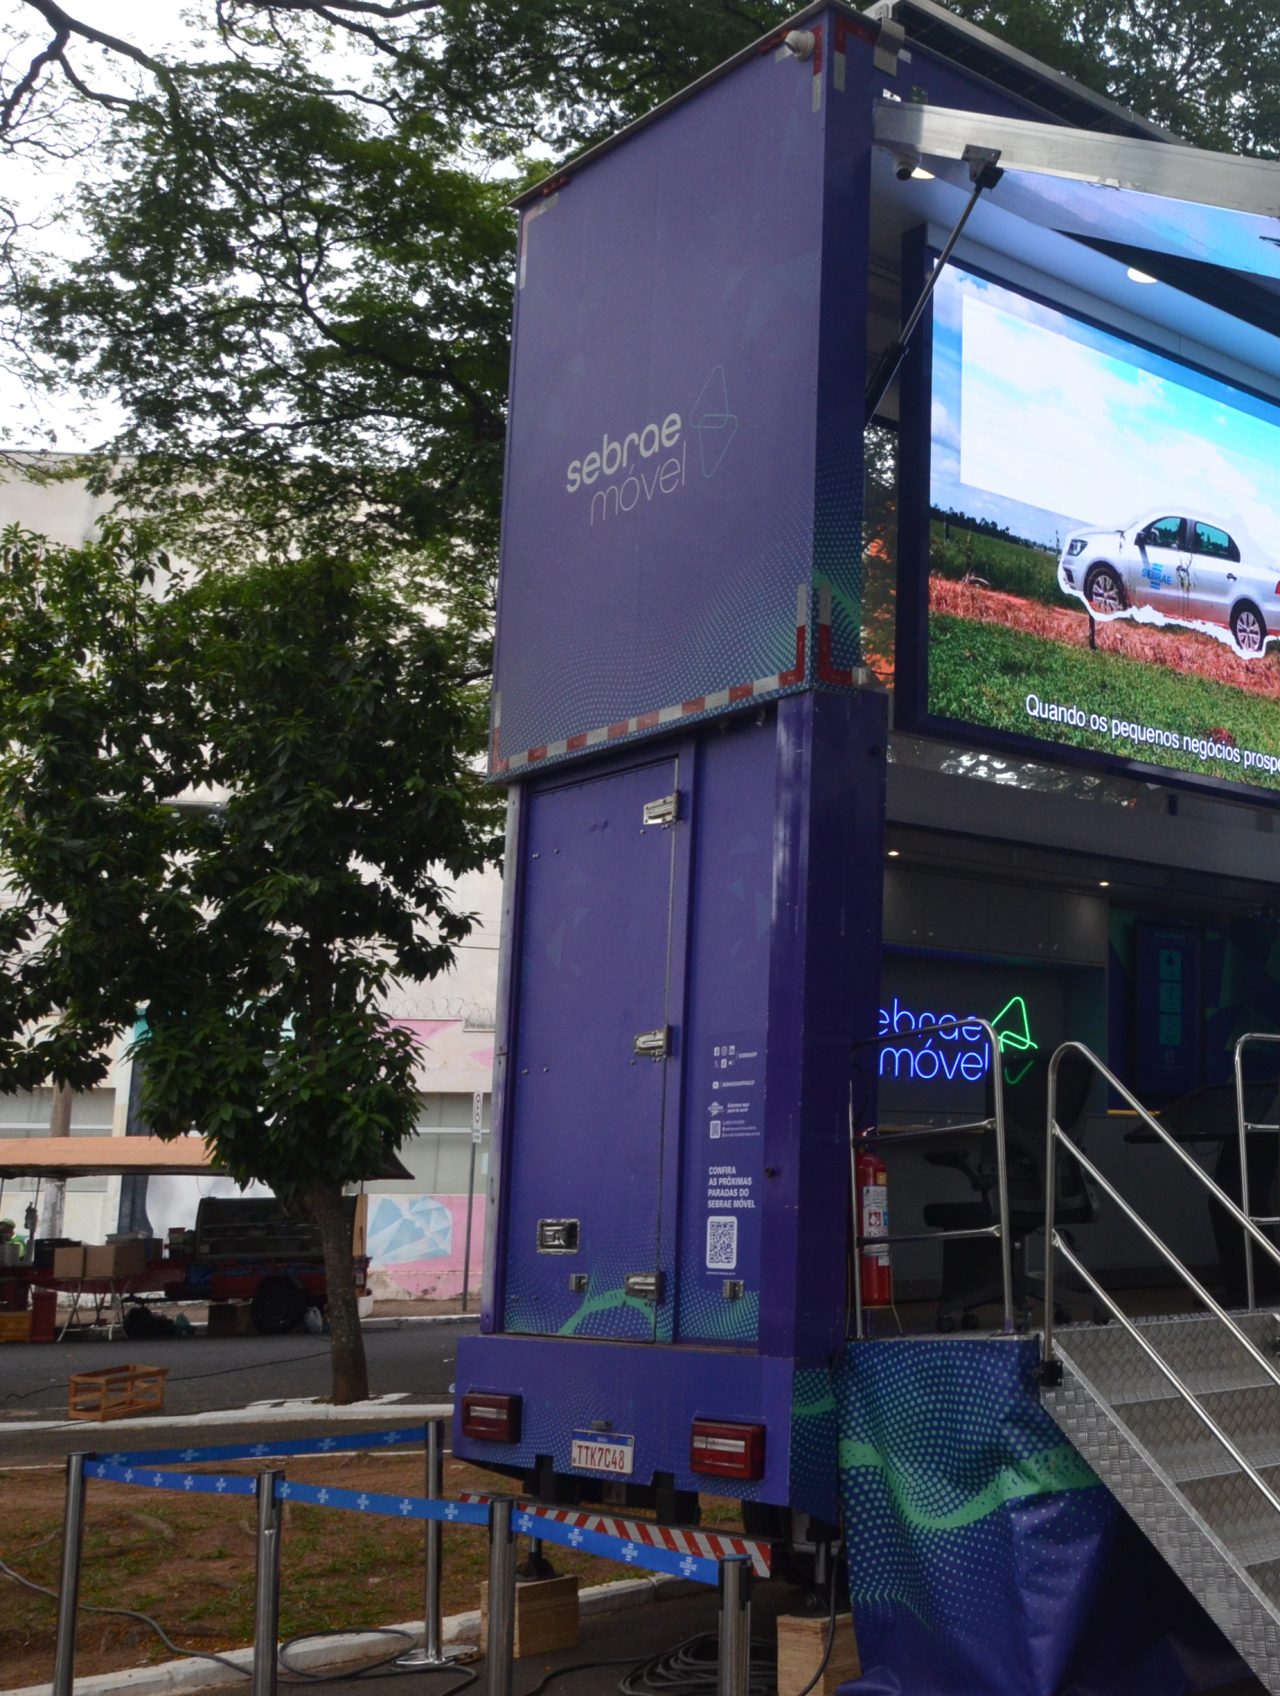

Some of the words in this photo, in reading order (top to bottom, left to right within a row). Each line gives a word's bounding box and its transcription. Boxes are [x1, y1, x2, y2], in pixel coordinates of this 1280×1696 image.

[566, 412, 681, 493] sebrae
[590, 440, 686, 526] móvel
[1141, 567, 1174, 585] SEBRAE
[1026, 693, 1086, 727] Quando
[1090, 713, 1108, 732] os
[1111, 719, 1180, 749] pequenos
[1183, 735, 1241, 763] negócios
[880, 1038, 990, 1081] móvel
[709, 1166, 736, 1175] CONFIRA
[709, 1178, 718, 1186] AS
[719, 1174, 752, 1186] PRÓXIMAS
[707, 1199, 732, 1208] SEBRAE
[733, 1197, 755, 1208] MÓVEL
[708, 1188, 738, 1198] PARADAS
[739, 1188, 749, 1197] DO
[577, 1444, 625, 1470] TTK7C48
